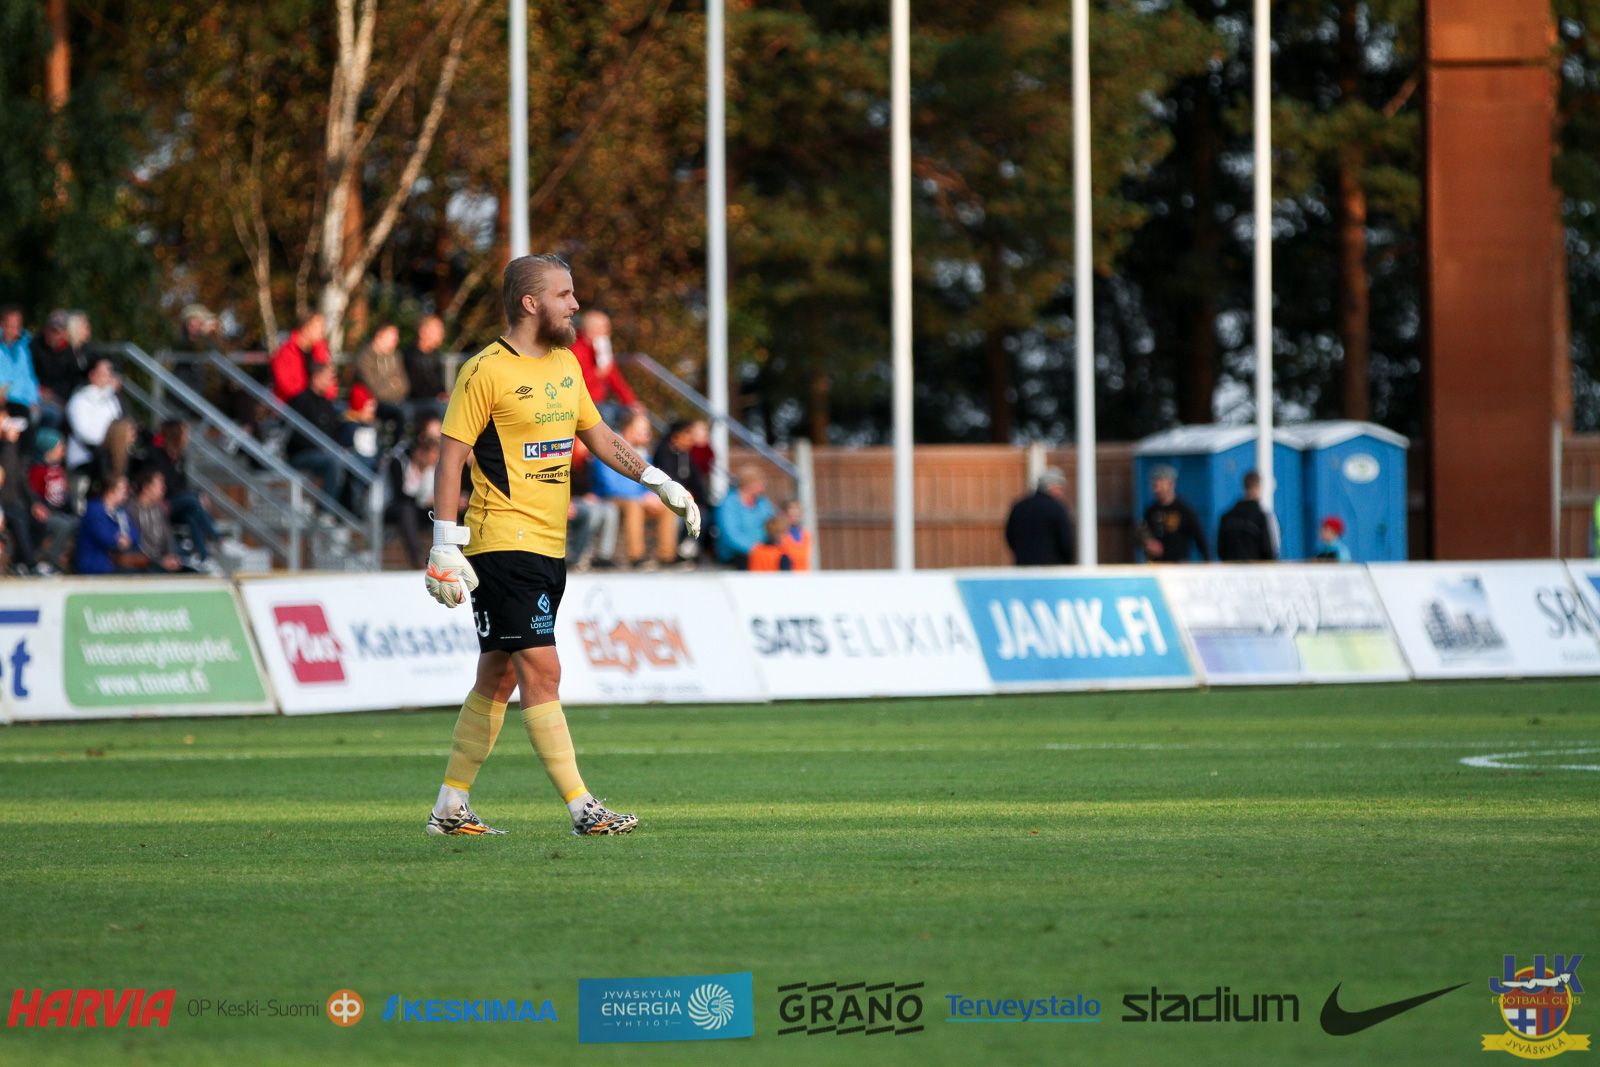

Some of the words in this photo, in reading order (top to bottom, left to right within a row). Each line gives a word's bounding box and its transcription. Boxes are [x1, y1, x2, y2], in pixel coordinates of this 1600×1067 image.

[535, 409, 574, 425] Sparbank
[526, 444, 538, 456] K
[525, 470, 563, 479] Premarin
[751, 617, 829, 656] SATS
[833, 613, 974, 656] ELIXIA
[990, 597, 1168, 659] JAMK.FI
